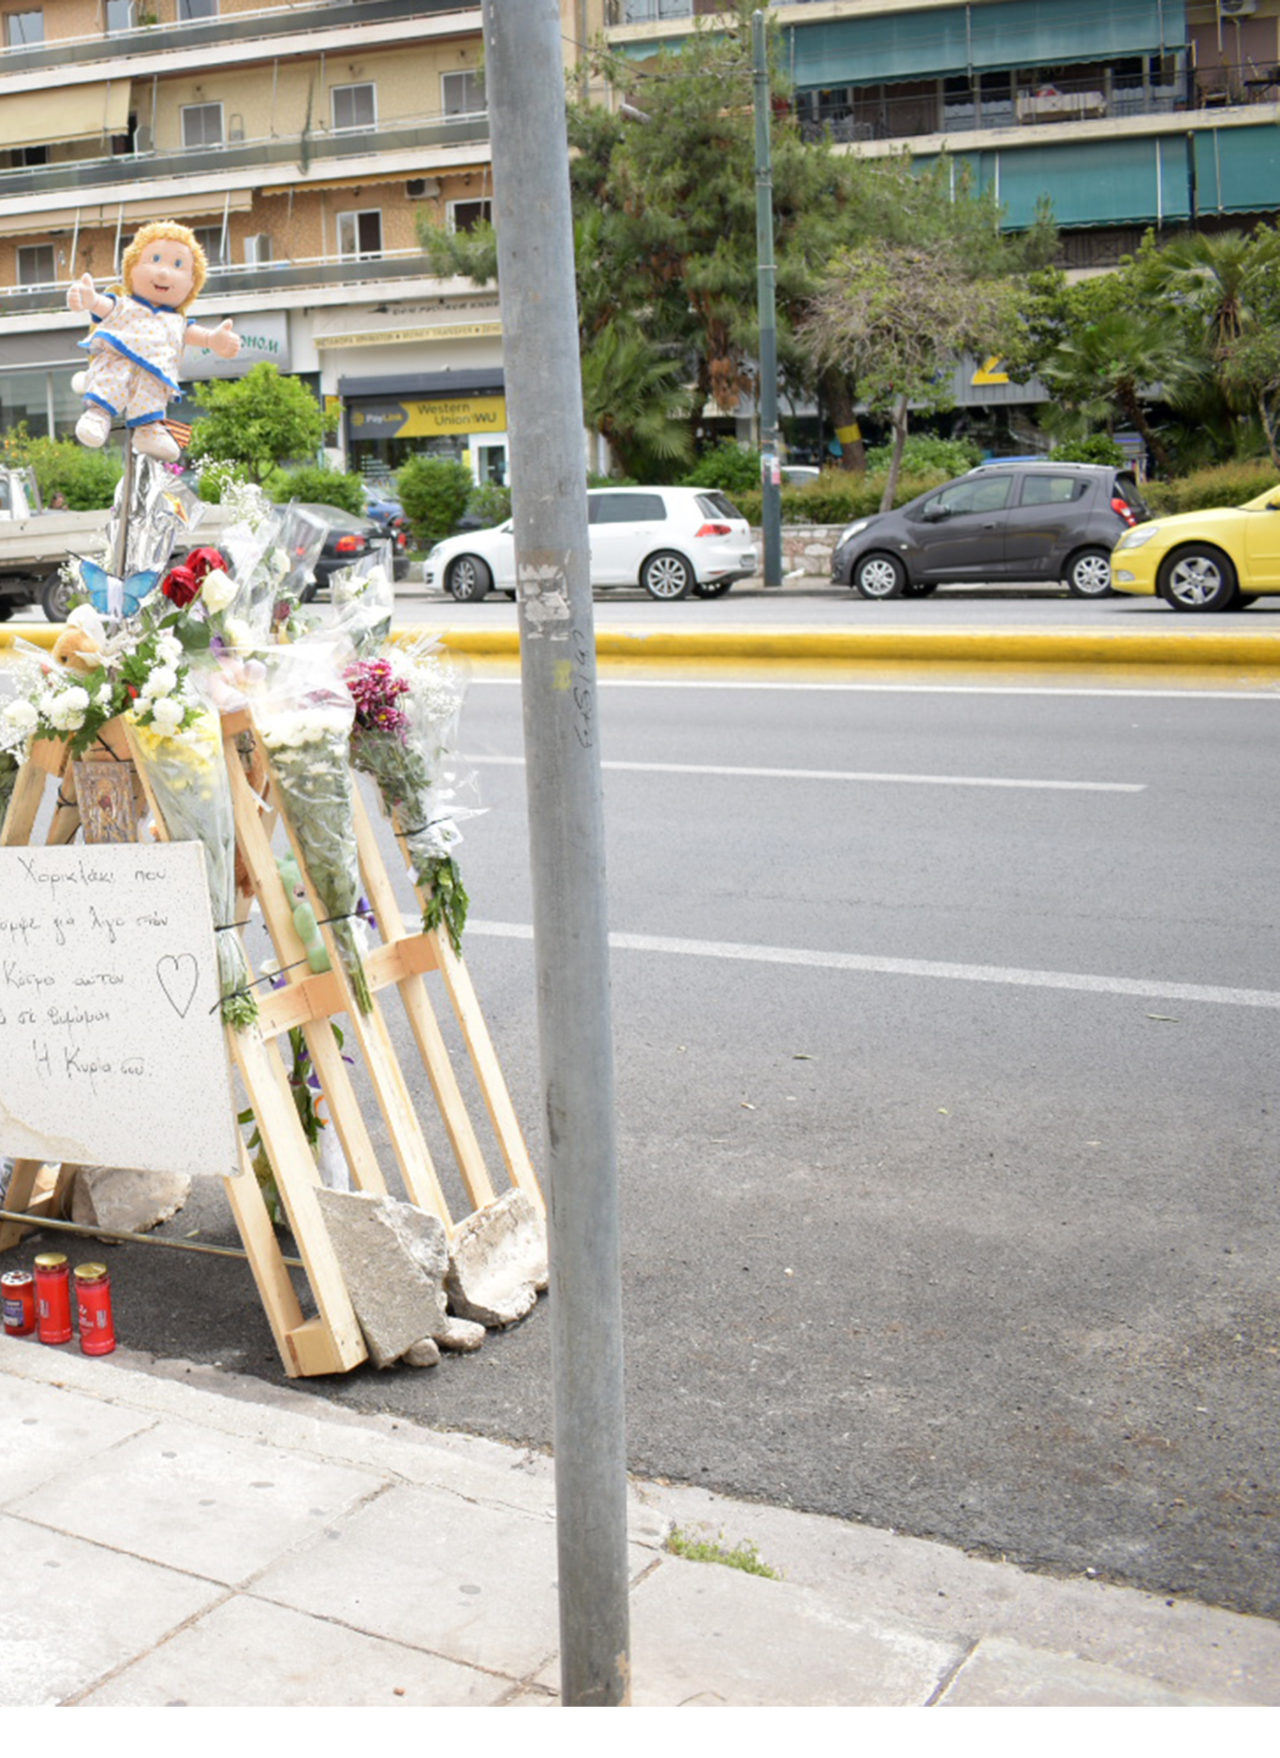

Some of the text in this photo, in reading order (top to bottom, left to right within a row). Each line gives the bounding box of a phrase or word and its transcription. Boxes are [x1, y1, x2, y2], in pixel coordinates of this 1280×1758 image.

[417, 403, 470, 415] Western
[366, 412, 403, 424] PayLink
[435, 411, 497, 426] Union WU
